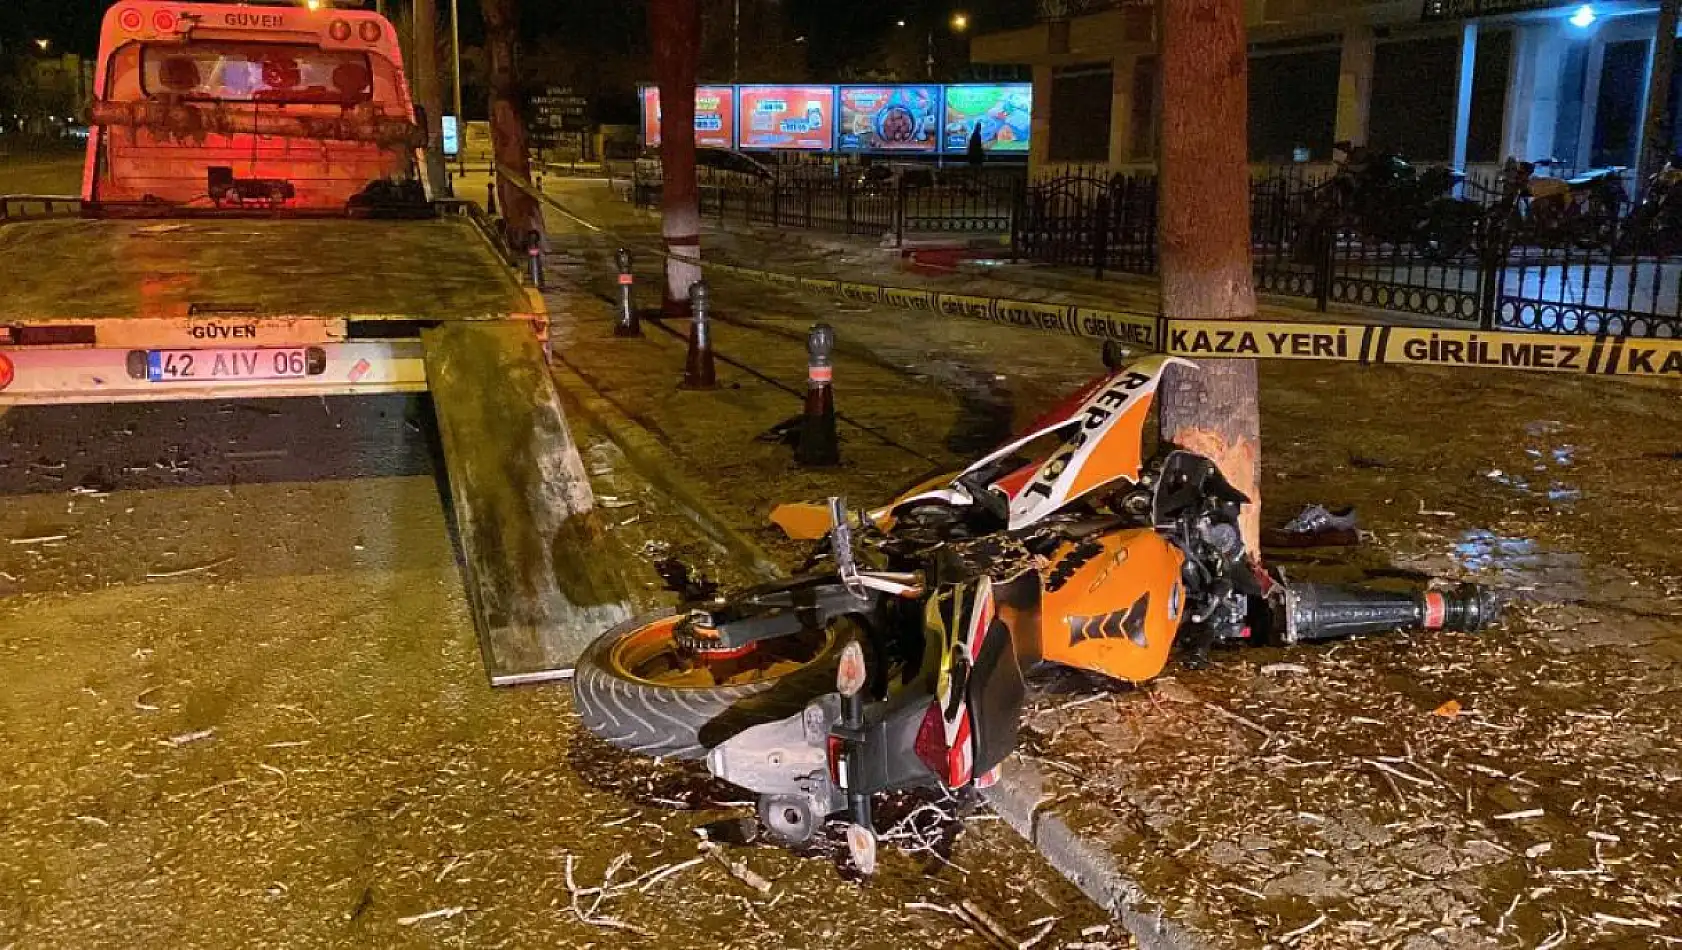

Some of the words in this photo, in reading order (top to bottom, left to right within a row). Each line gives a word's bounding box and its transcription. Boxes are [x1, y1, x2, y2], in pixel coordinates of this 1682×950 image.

[193, 323, 256, 338] GÜVEN
[1171, 329, 1260, 353] KAZA
[1267, 328, 1348, 357] YERİ
[164, 353, 194, 376] 42
[211, 352, 258, 376] AIV
[274, 351, 304, 374] 06
[1404, 332, 1582, 368] GİRİLMEZ
